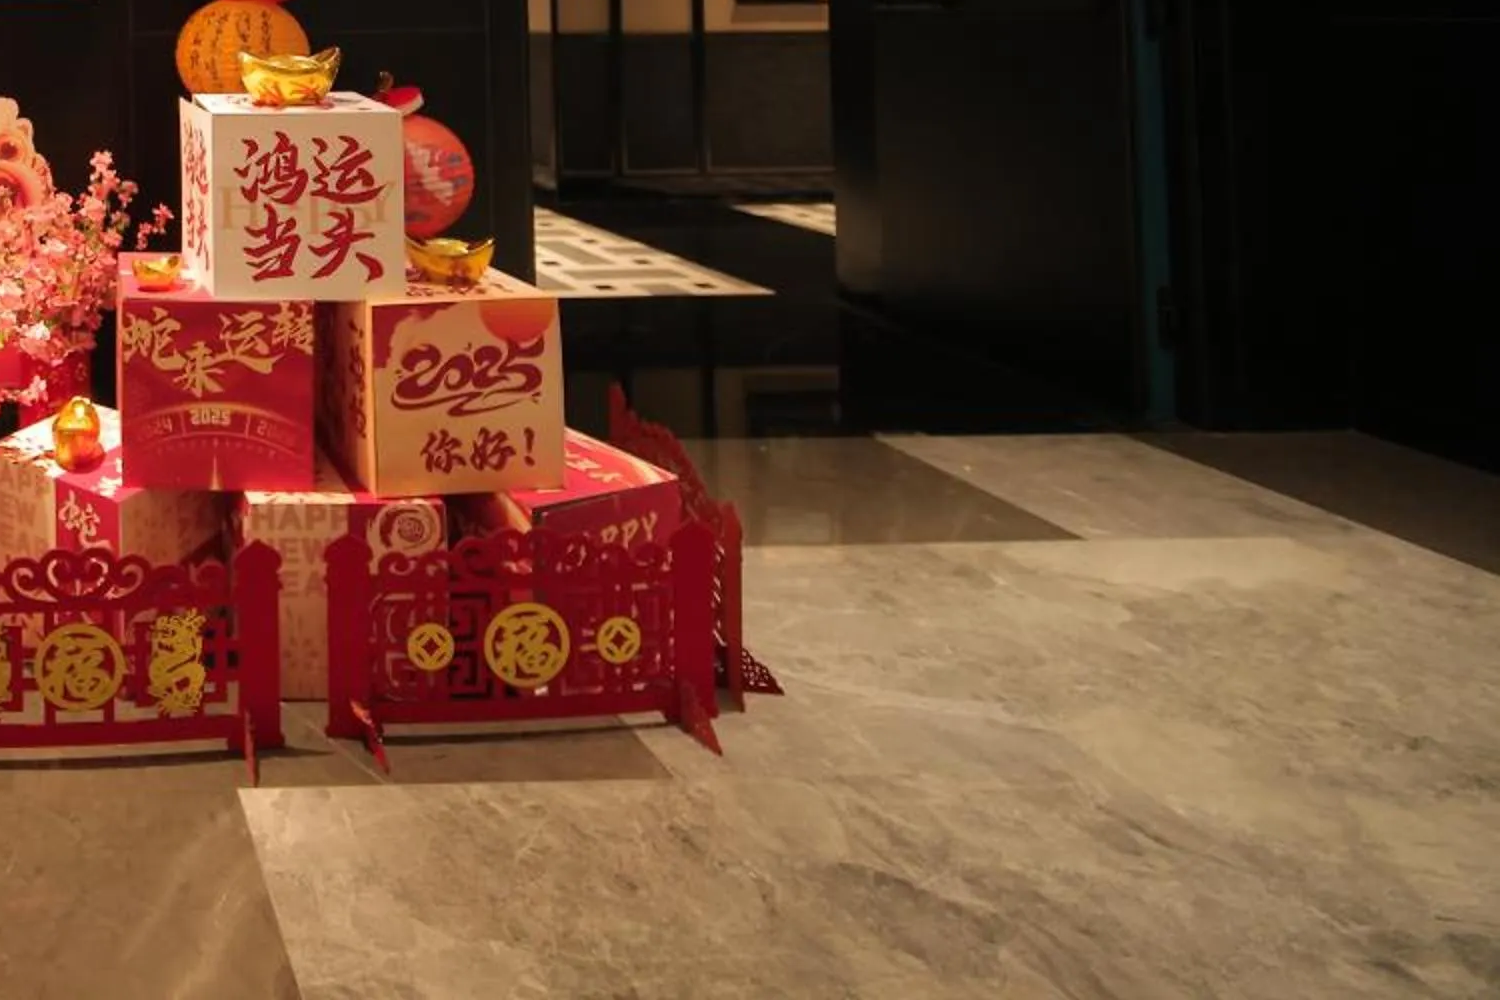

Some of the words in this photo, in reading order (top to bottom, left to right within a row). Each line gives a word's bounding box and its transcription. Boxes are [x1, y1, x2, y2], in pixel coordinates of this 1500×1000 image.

[233, 130, 388, 204] 鸿运
[242, 203, 385, 282] 当头
[392, 334, 545, 416] 2025
[190, 407, 232, 426] 2025
[41, 630, 120, 705] 福
[491, 611, 564, 681] 福
